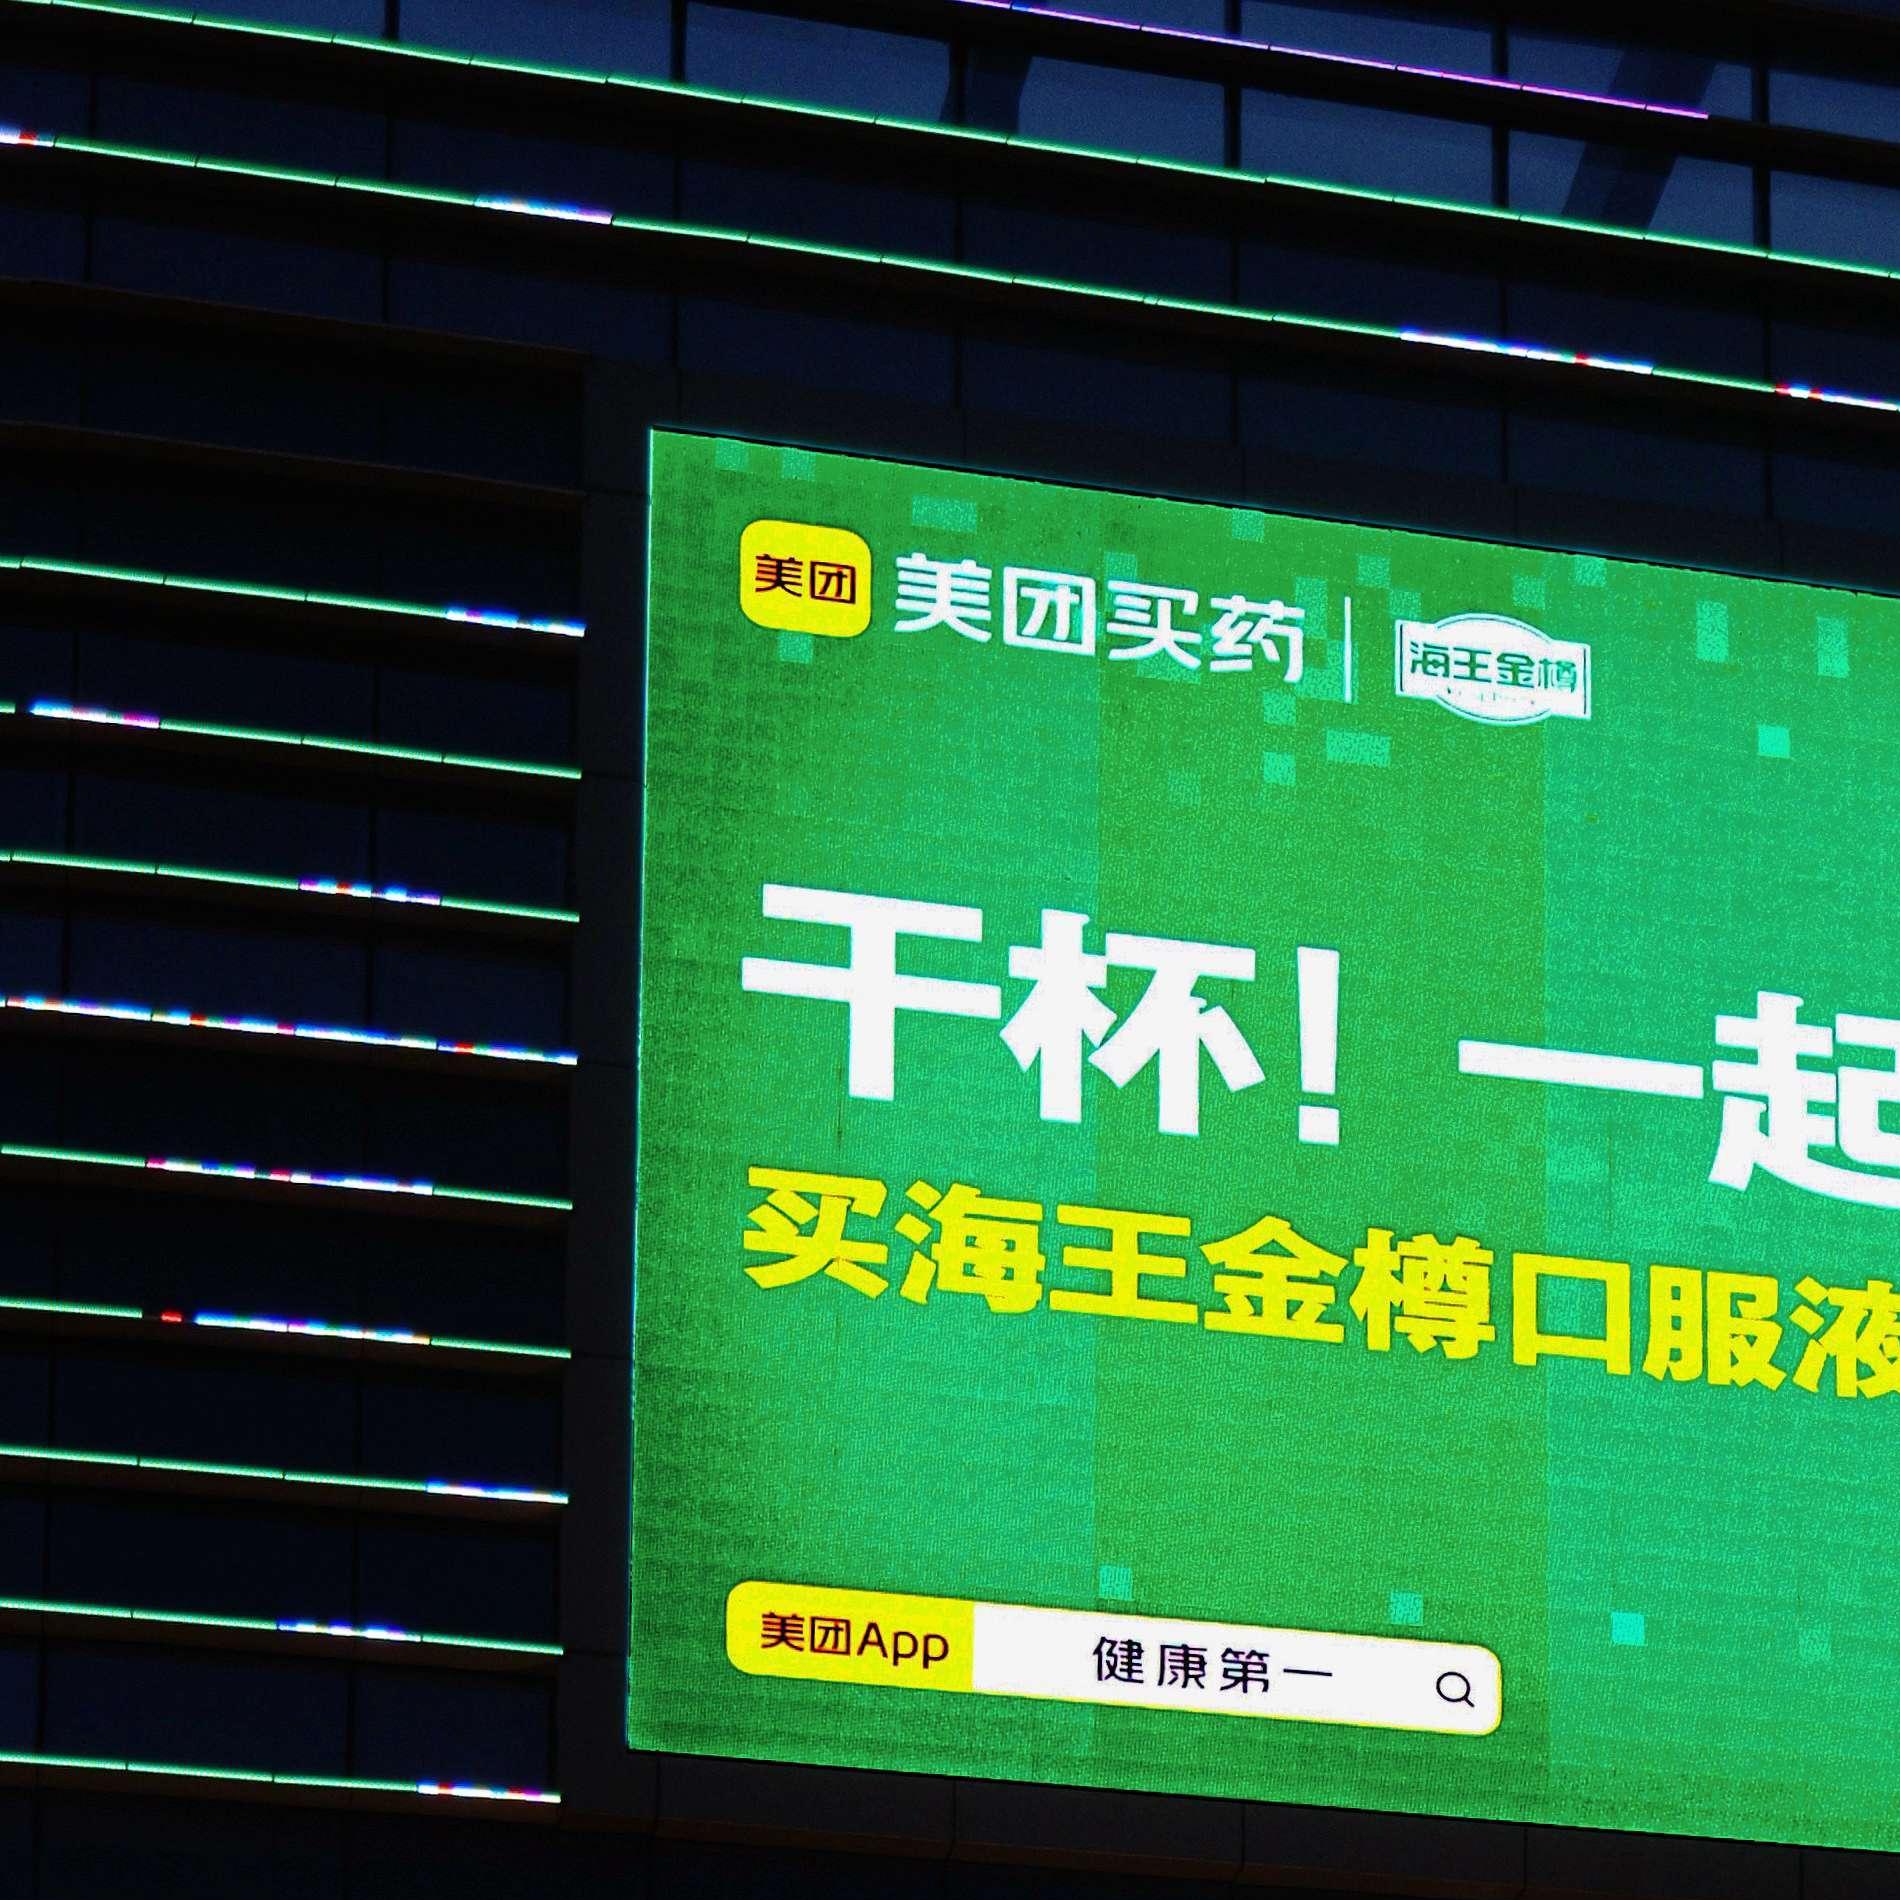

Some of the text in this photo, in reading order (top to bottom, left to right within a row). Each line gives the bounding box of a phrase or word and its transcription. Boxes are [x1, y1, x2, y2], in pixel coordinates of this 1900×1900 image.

[755, 553, 1304, 682] 美团 美团买药
[760, 1611, 950, 1670] 美团App
[1092, 1636, 1333, 1693] 健康第一
